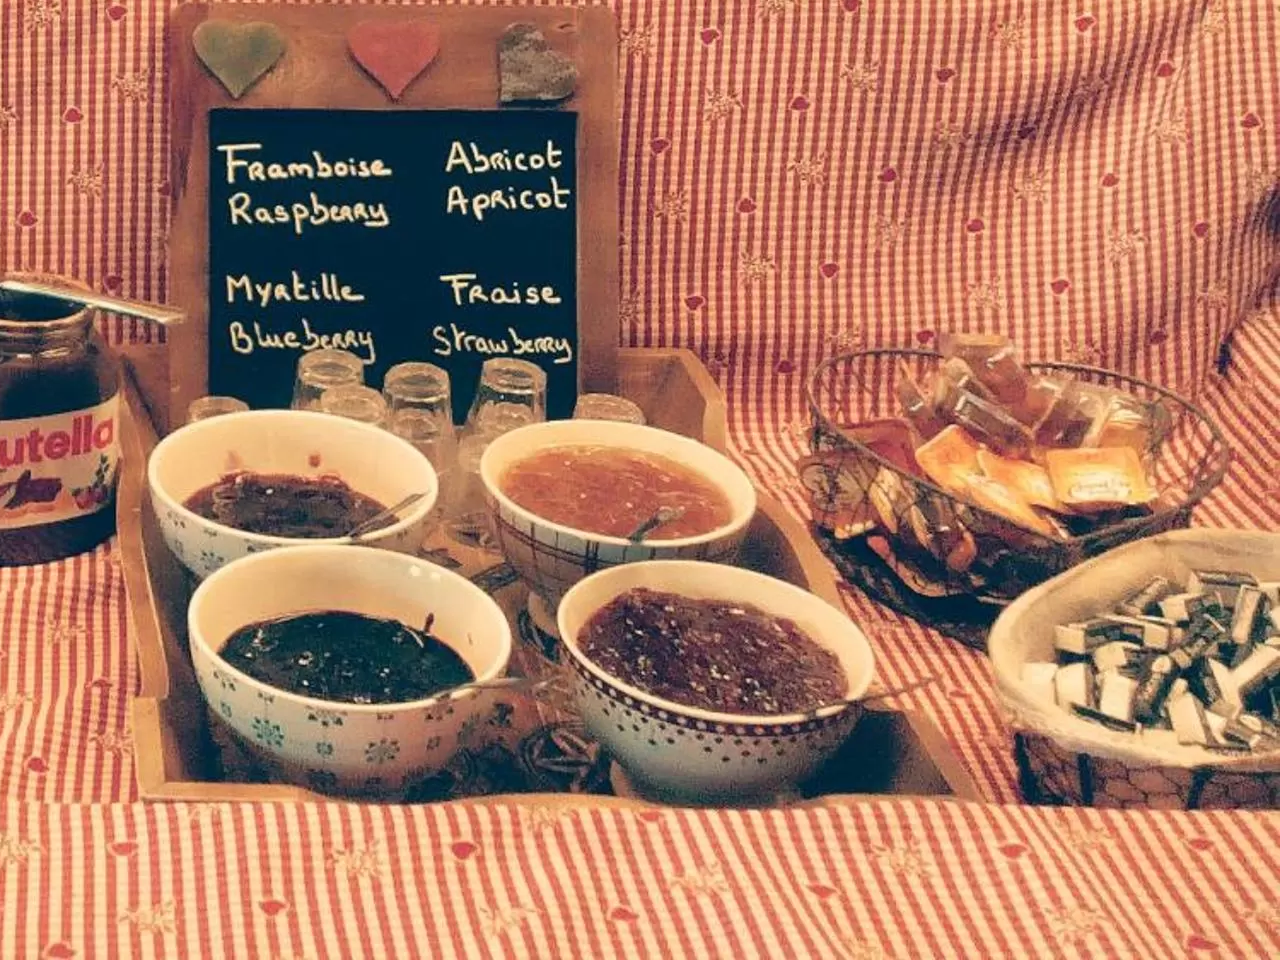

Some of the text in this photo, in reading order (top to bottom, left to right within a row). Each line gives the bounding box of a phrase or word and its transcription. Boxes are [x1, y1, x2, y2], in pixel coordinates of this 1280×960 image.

[217, 142, 393, 184] Framboise
[445, 140, 563, 175] Abricot
[227, 191, 390, 235] Raspberry
[446, 177, 571, 221] Apricot
[226, 270, 366, 308] Myrtille
[439, 273, 562, 305] Fraise
[229, 318, 375, 365] Blueberry
[431, 323, 573, 365] Strawberry
